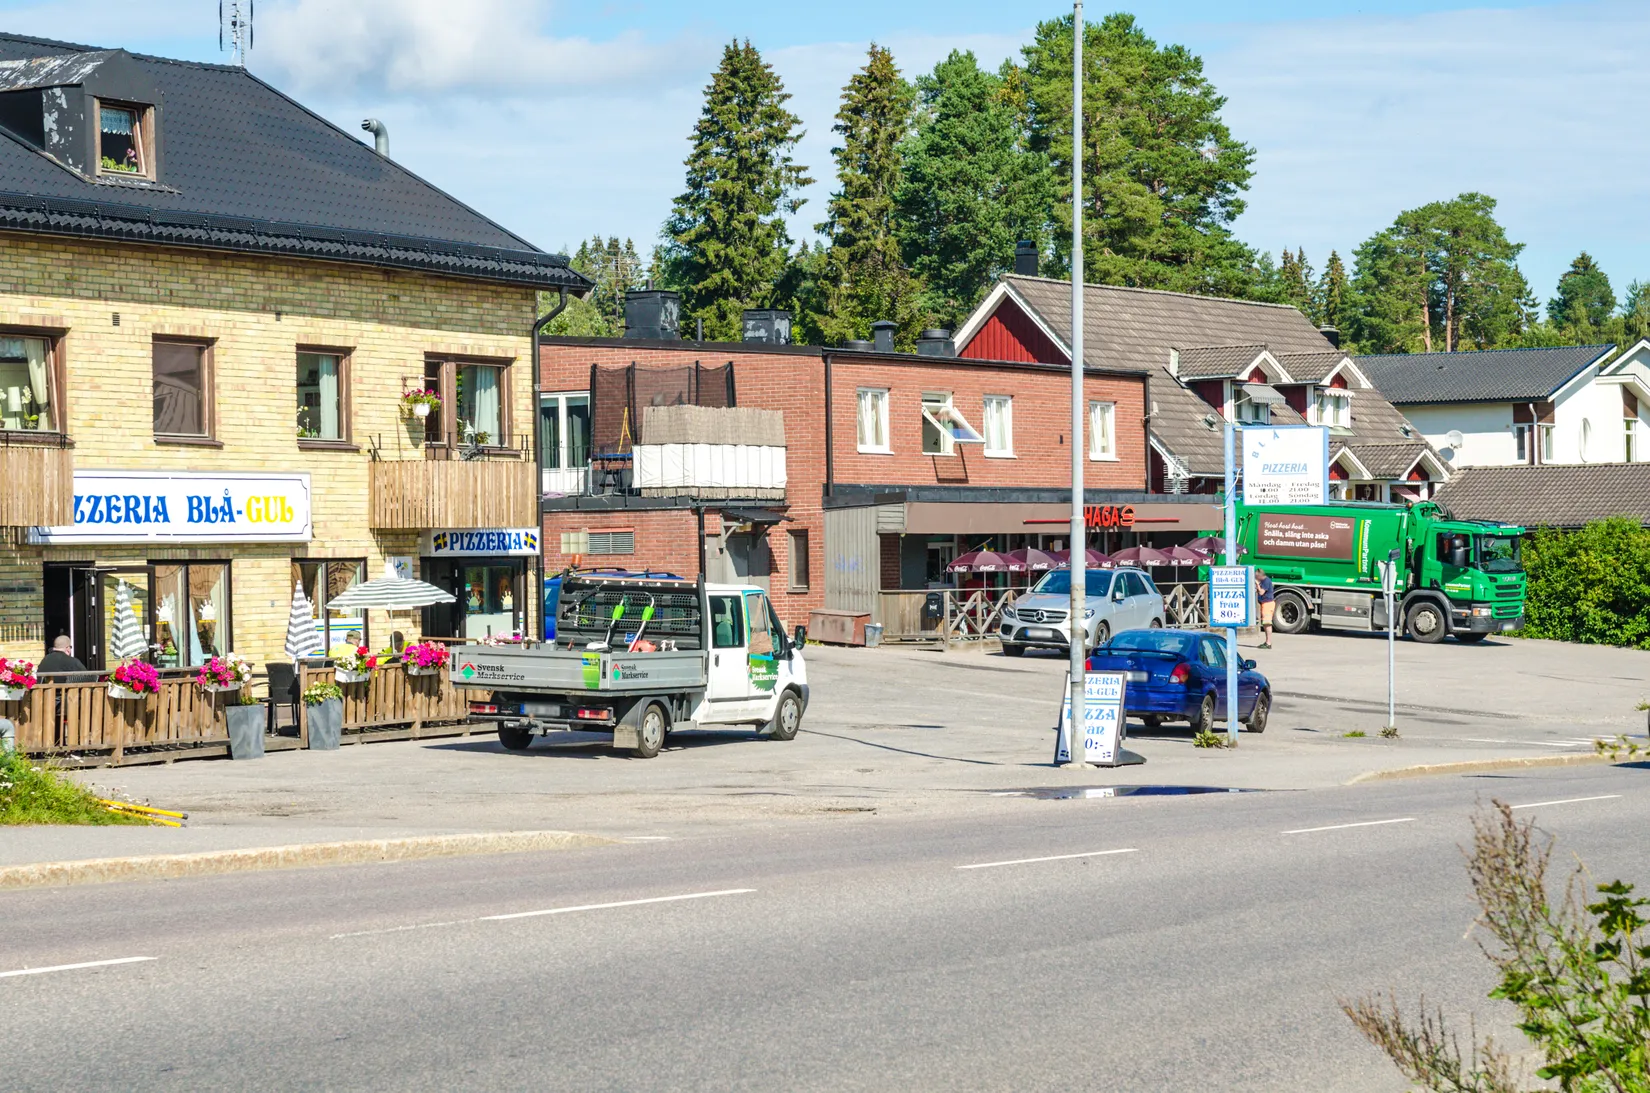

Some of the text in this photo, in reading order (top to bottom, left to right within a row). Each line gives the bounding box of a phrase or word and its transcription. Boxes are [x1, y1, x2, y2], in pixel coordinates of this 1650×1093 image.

[1261, 463, 1308, 473] PIZZERIA
[73, 488, 294, 524] ZZERIA BLÅ-GUL
[1083, 506, 1120, 527] HAGA
[1264, 529, 1329, 540] Snälla, släng inte aska
[449, 532, 523, 551] PIZZERIA
[1263, 538, 1327, 549] och damm utan påse!
[1213, 591, 1245, 599] PIZZA
[477, 664, 505, 672] Svensk
[476, 671, 525, 681] Markservice
[621, 670, 649, 680] Markservice
[1085, 677, 1120, 685] ZERIA
[1085, 722, 1105, 735] ån
[1085, 738, 1104, 749] 0:-
